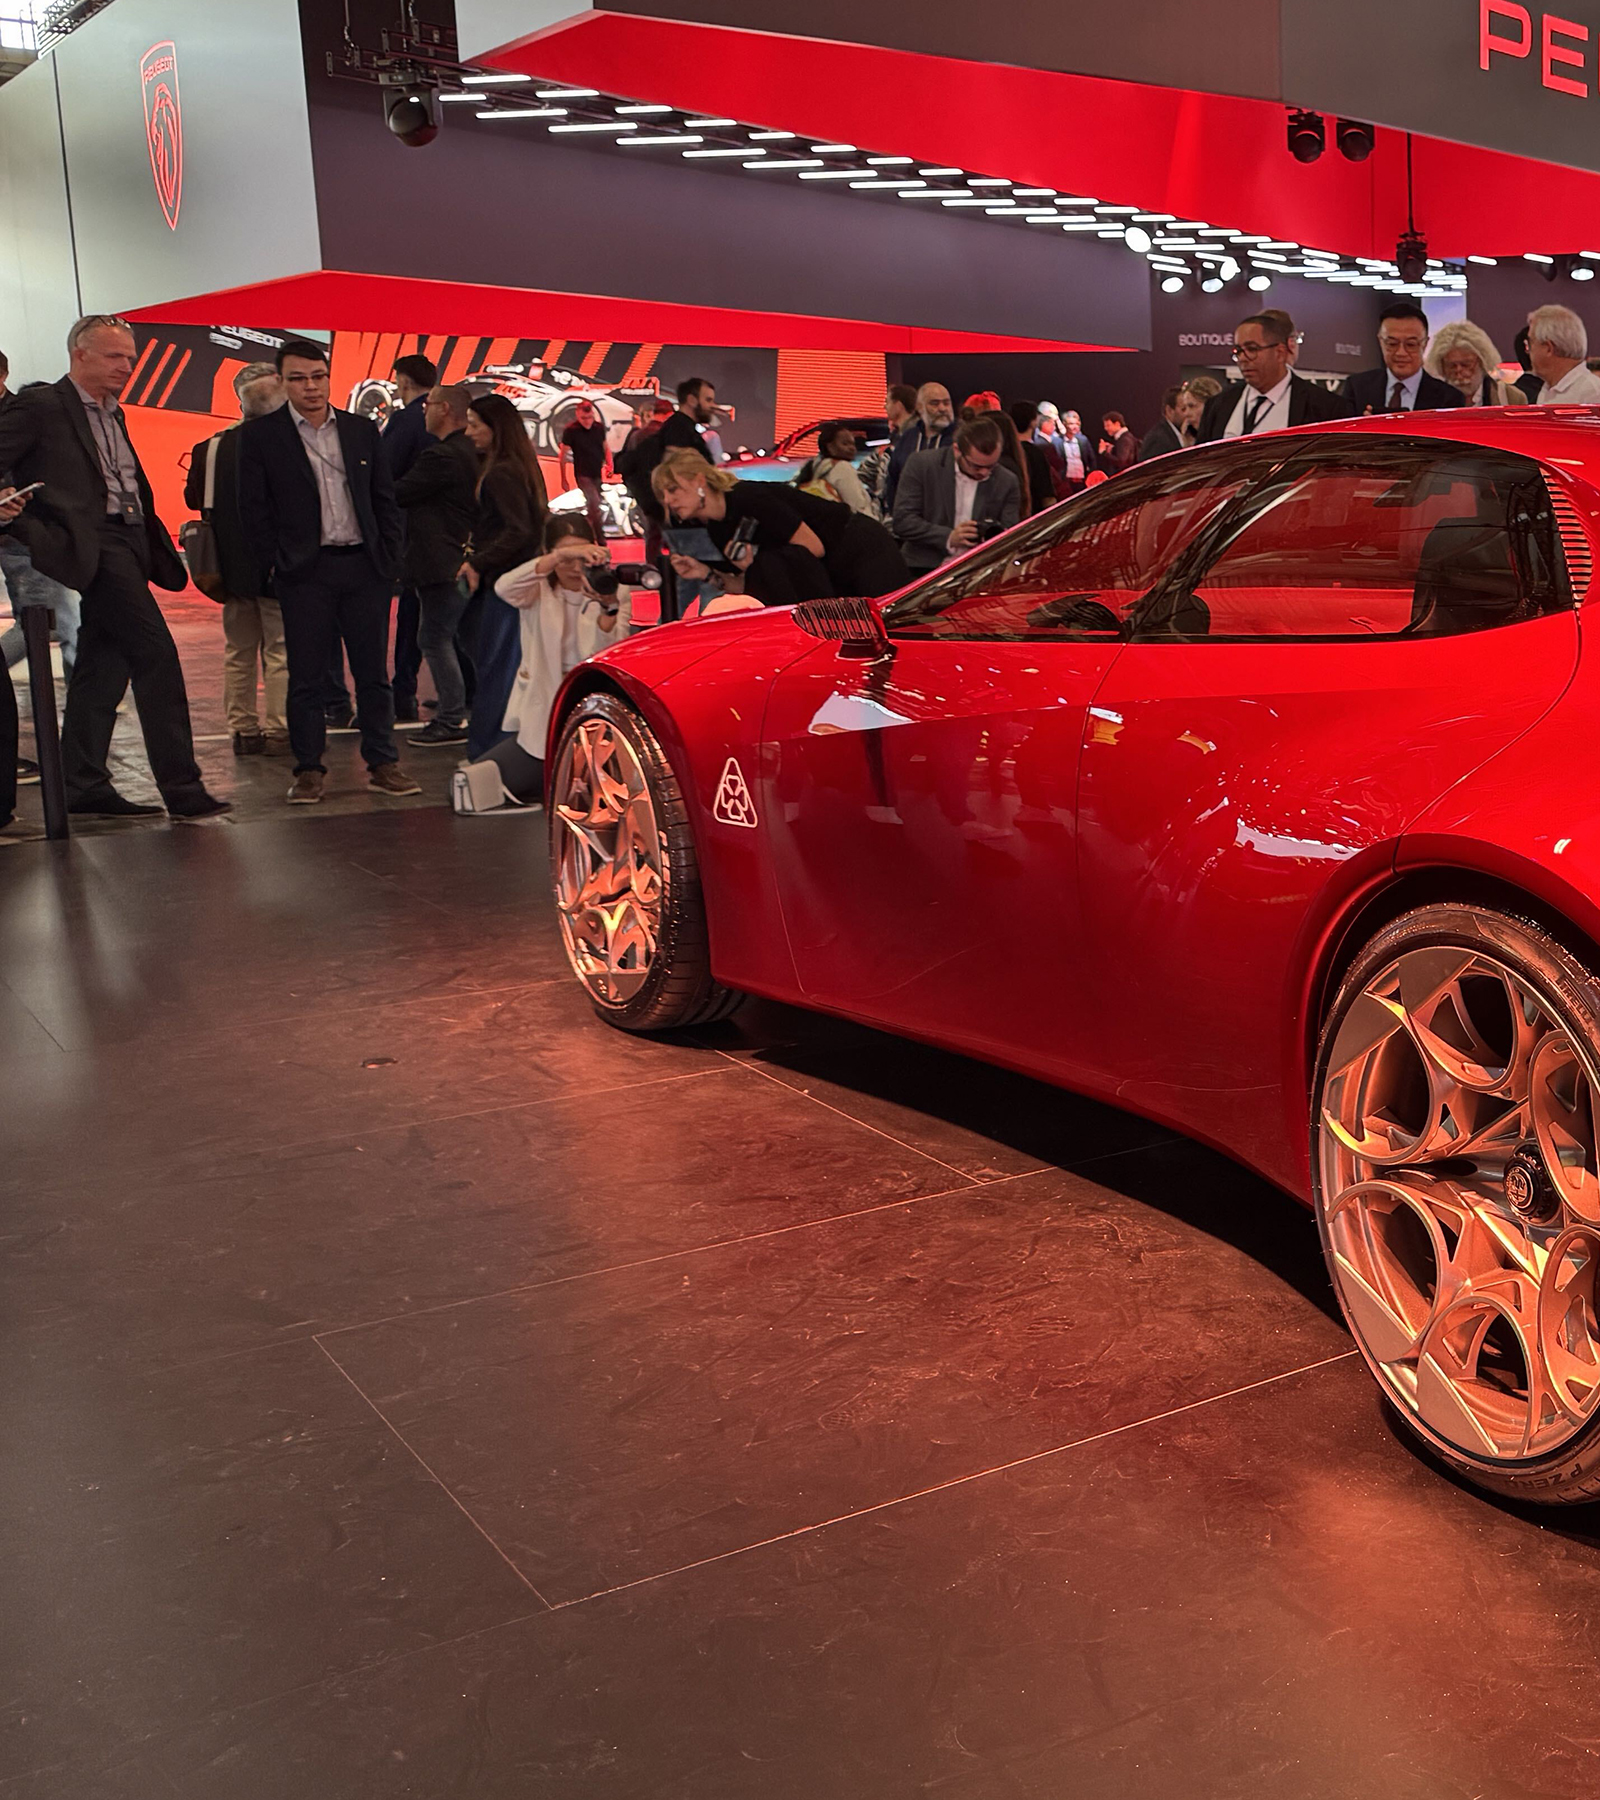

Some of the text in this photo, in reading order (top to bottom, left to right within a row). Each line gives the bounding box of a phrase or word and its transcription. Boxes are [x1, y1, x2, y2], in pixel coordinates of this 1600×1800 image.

[144, 56, 173, 84] PEUGEOT
[210, 325, 285, 349] EUGEOT
[1178, 333, 1234, 346] BOUTIQUE
